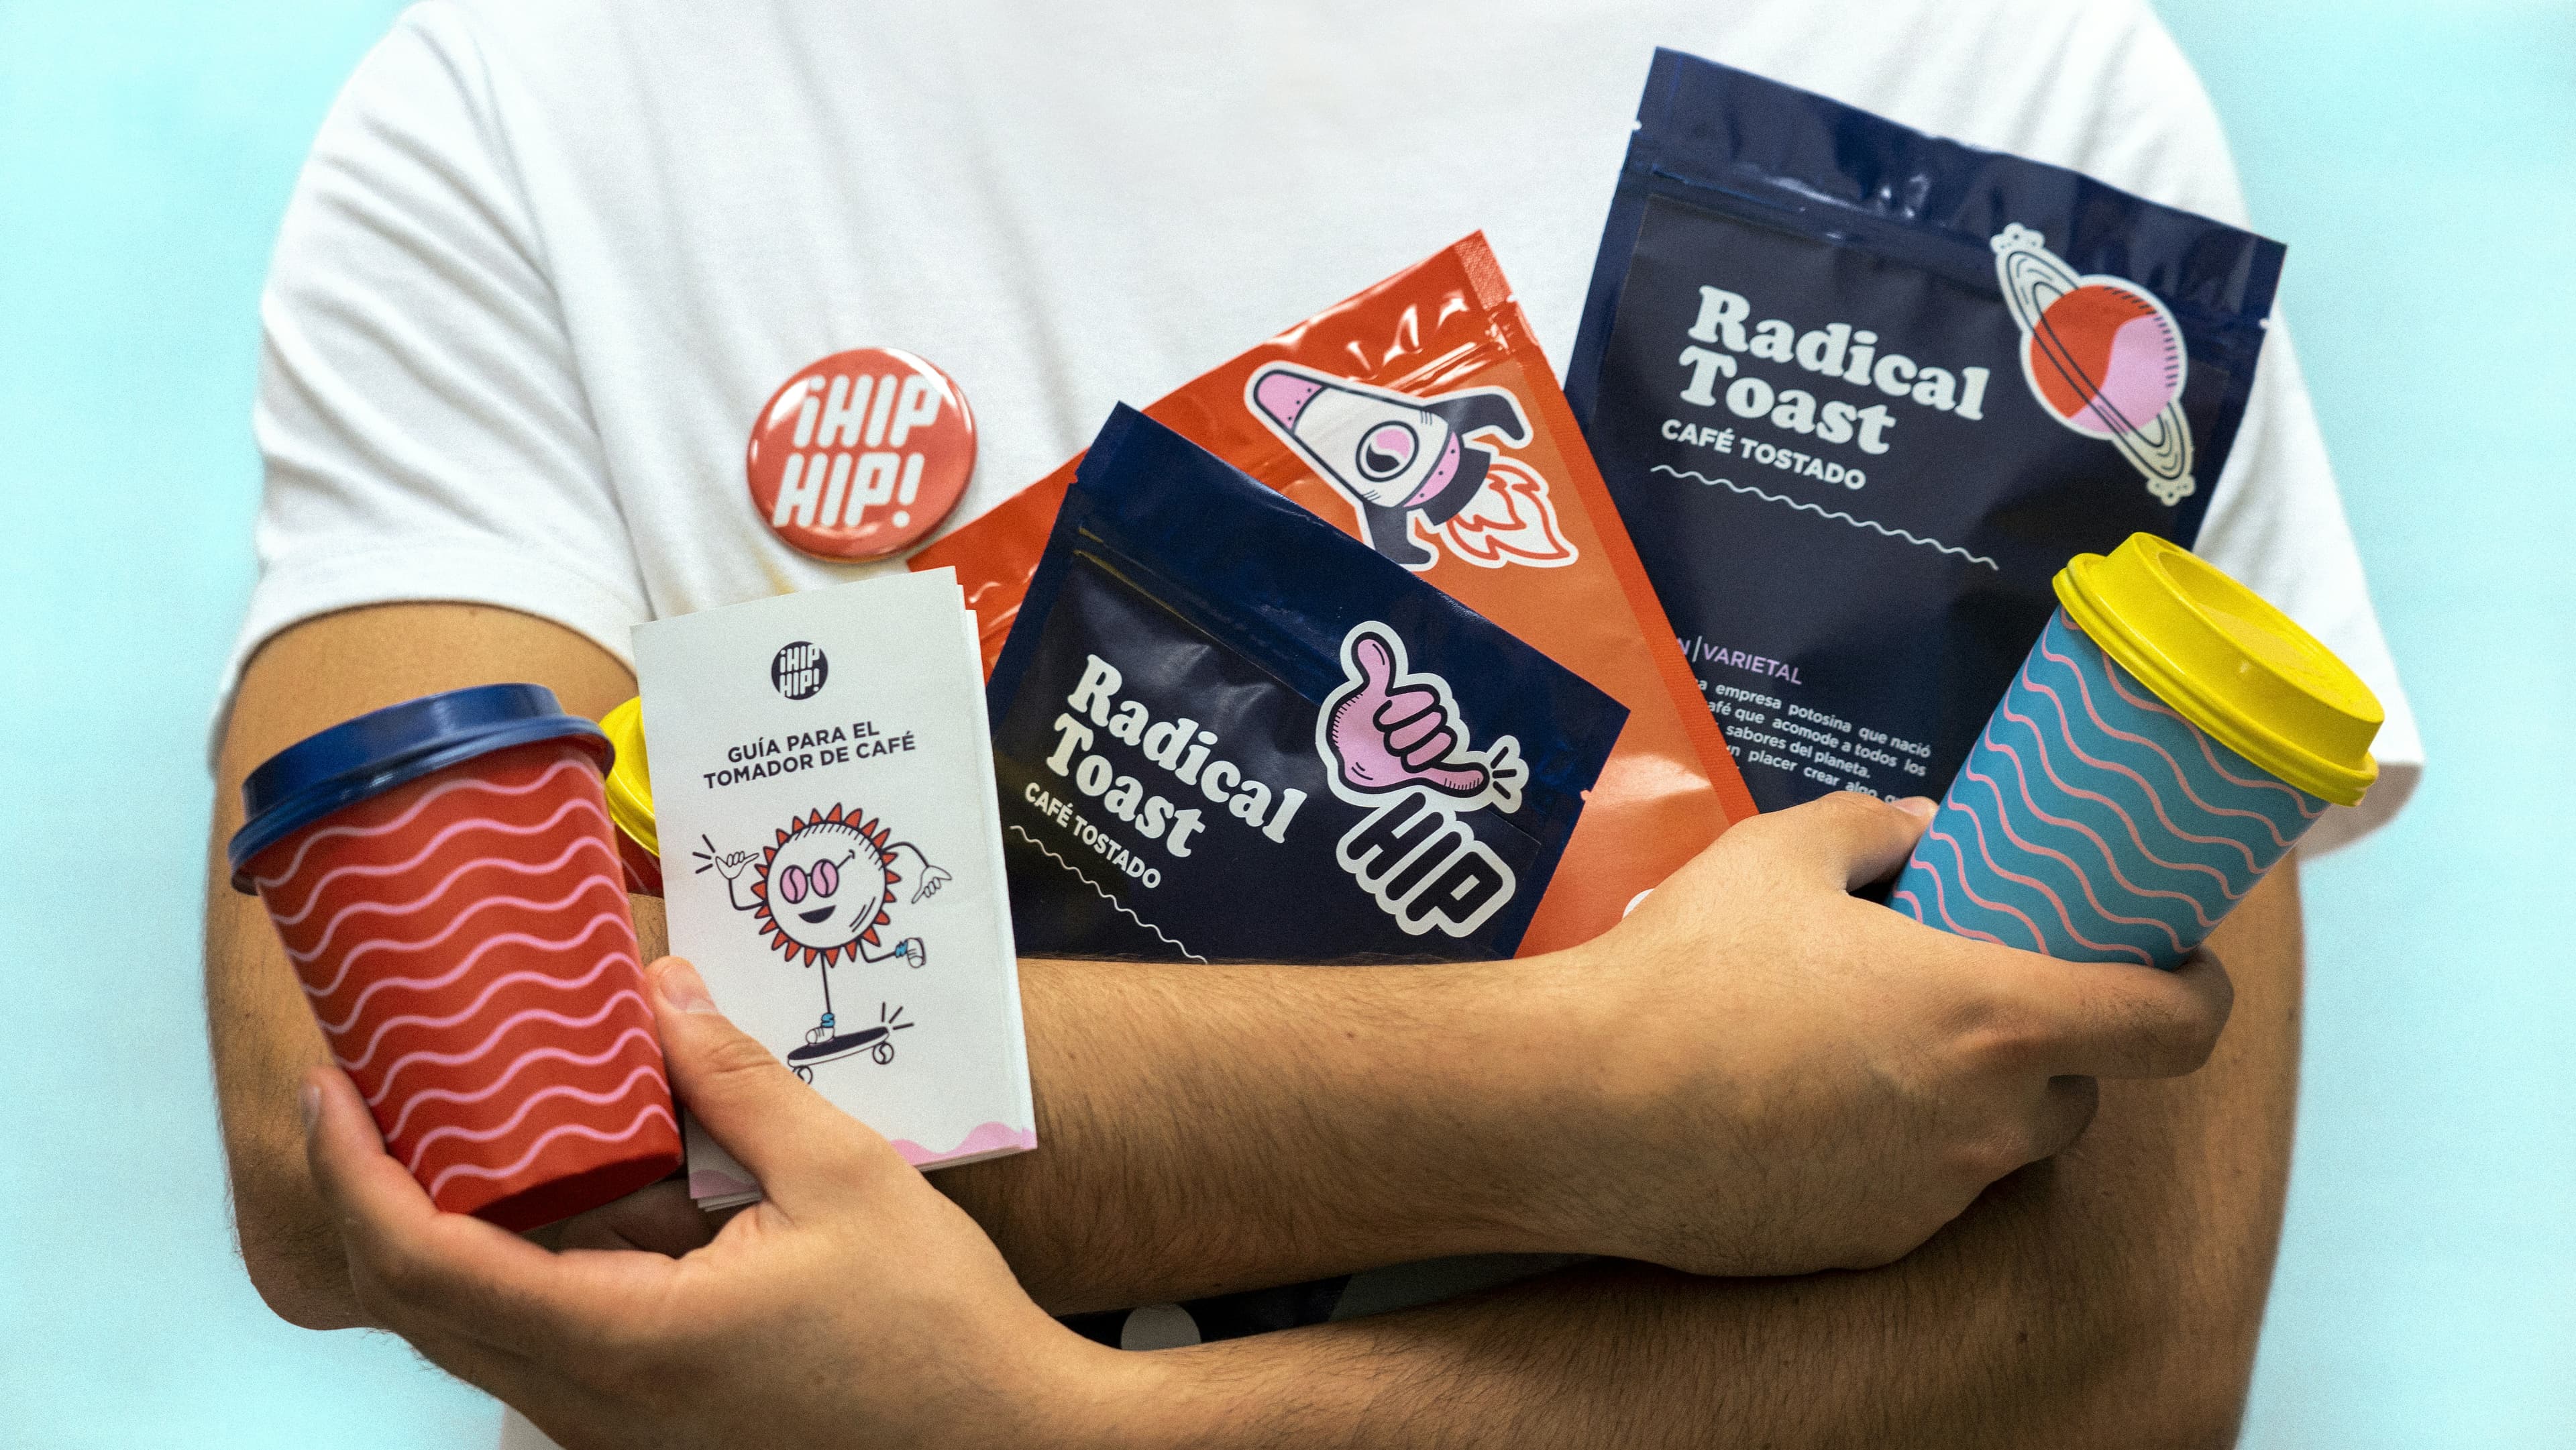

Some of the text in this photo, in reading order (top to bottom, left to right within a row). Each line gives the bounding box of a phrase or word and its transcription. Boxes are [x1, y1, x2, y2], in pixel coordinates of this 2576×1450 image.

[1688, 285, 1990, 420] Radical
[792, 374, 943, 448] ¡HIP
[1679, 346, 1896, 454] Toast
[772, 452, 925, 528] HIP!
[1661, 419, 1866, 489] CAFÉ TOSTADO
[779, 668, 820, 698] HIP!
[780, 643, 820, 673] ¡HIP
[1703, 643, 1802, 685] VARIETAL
[728, 721, 880, 763] GUÍA PARA EL
[1067, 654, 1308, 844] Radical
[1708, 701, 1927, 777] afé que acomode a todos los
[1715, 684, 1782, 709] empresa
[1788, 705, 1852, 733] potosina
[1859, 727, 1888, 744] que
[1890, 737, 1931, 758] nació
[1725, 725, 1871, 779] sabores del planeta.
[704, 731, 916, 789] TOMADOR DE CAFÉ
[1046, 713, 1207, 858] Toast
[1748, 749, 1798, 771] placer
[1803, 766, 1840, 786] crear
[1024, 782, 1161, 889] CAFÉ TOSTADO
[1346, 792, 1505, 924] HIP
